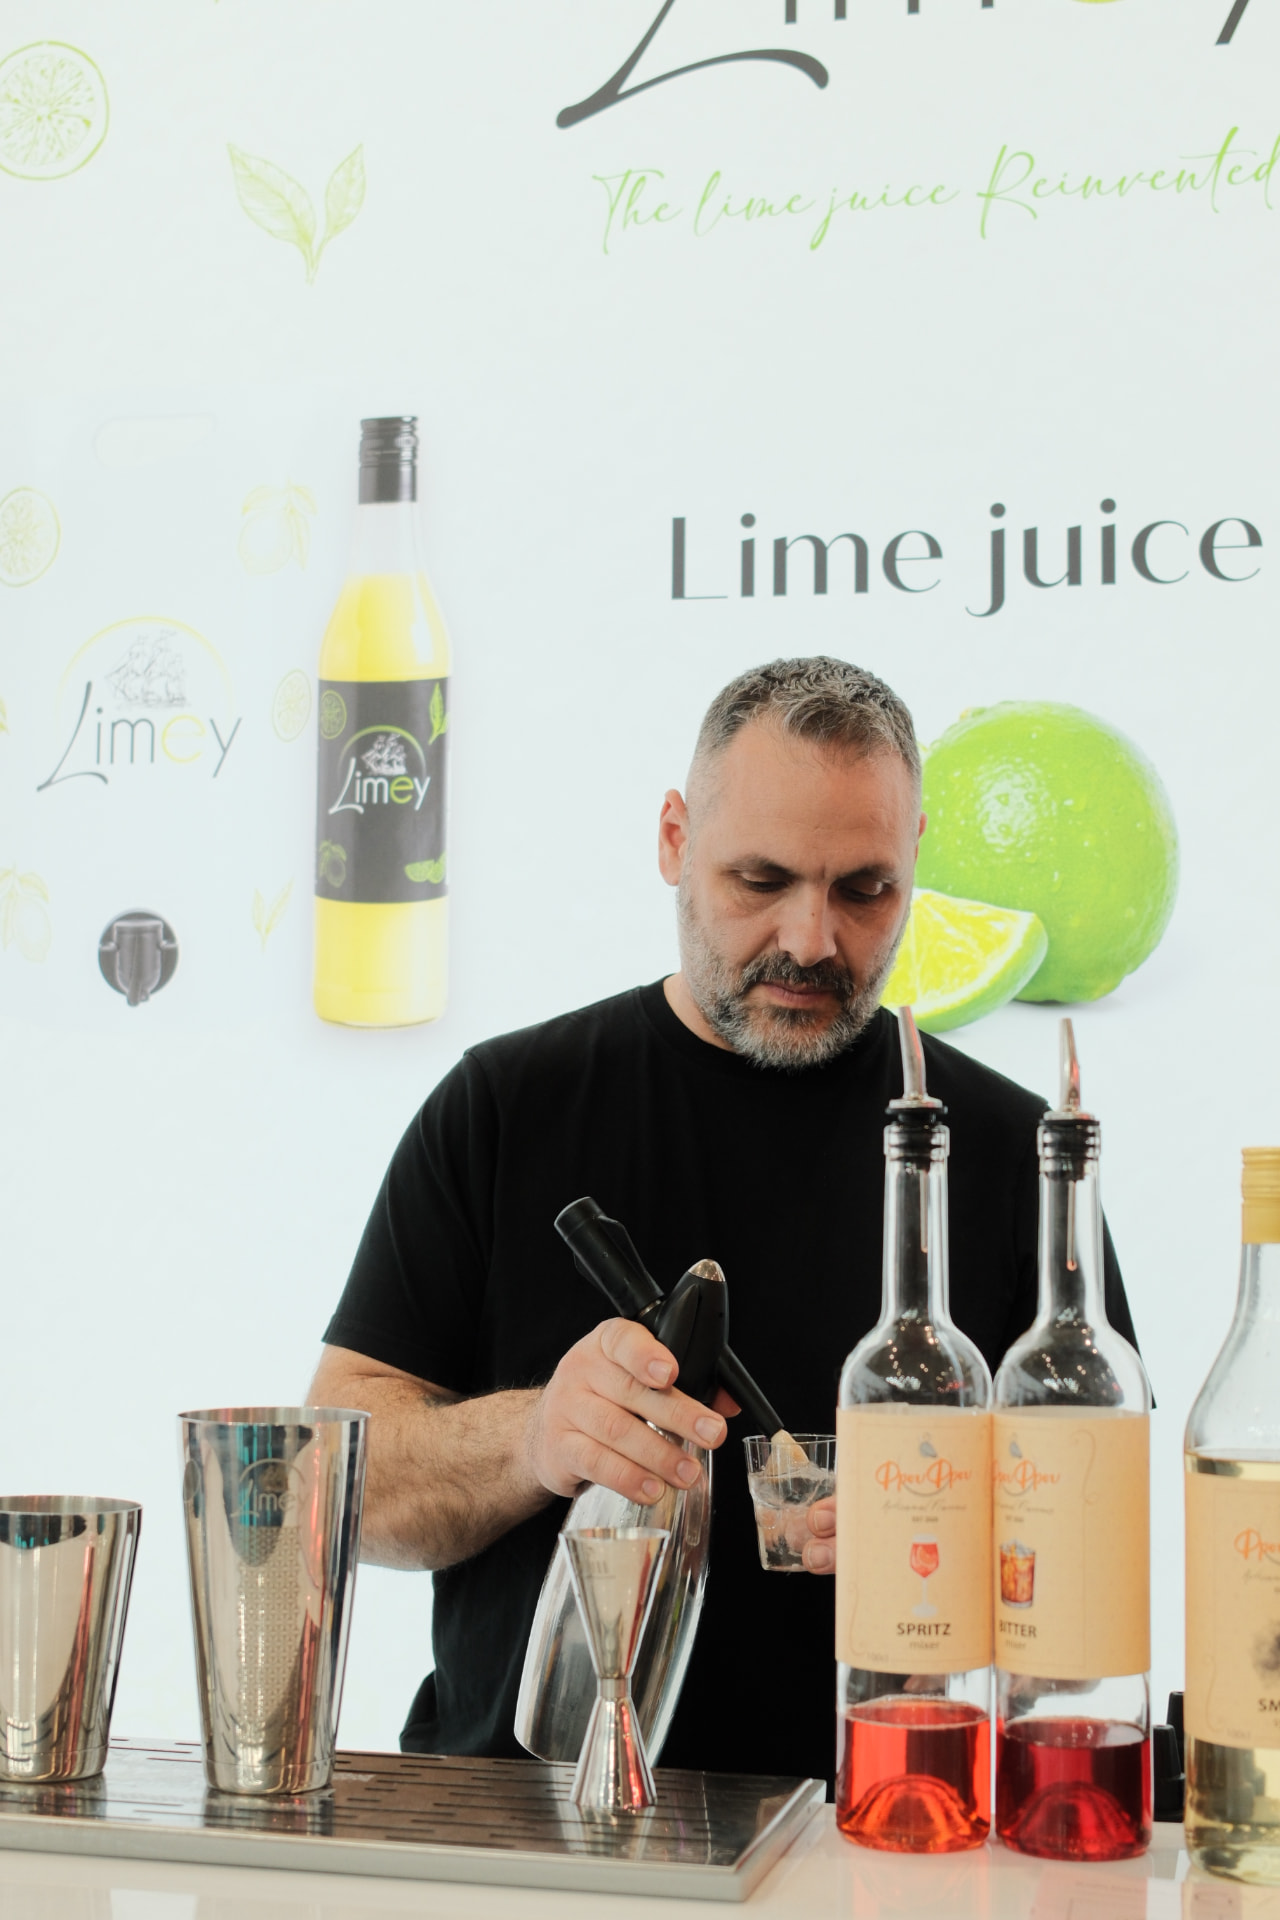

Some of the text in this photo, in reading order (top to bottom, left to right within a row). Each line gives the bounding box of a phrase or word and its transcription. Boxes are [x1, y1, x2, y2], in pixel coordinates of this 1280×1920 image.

[592, 126, 1280, 255] The lime juice Reinvented
[671, 498, 1263, 617] Lime juice
[36, 680, 242, 792] Limey
[328, 757, 431, 815] Limey
[897, 1622, 951, 1636] SPRITZ
